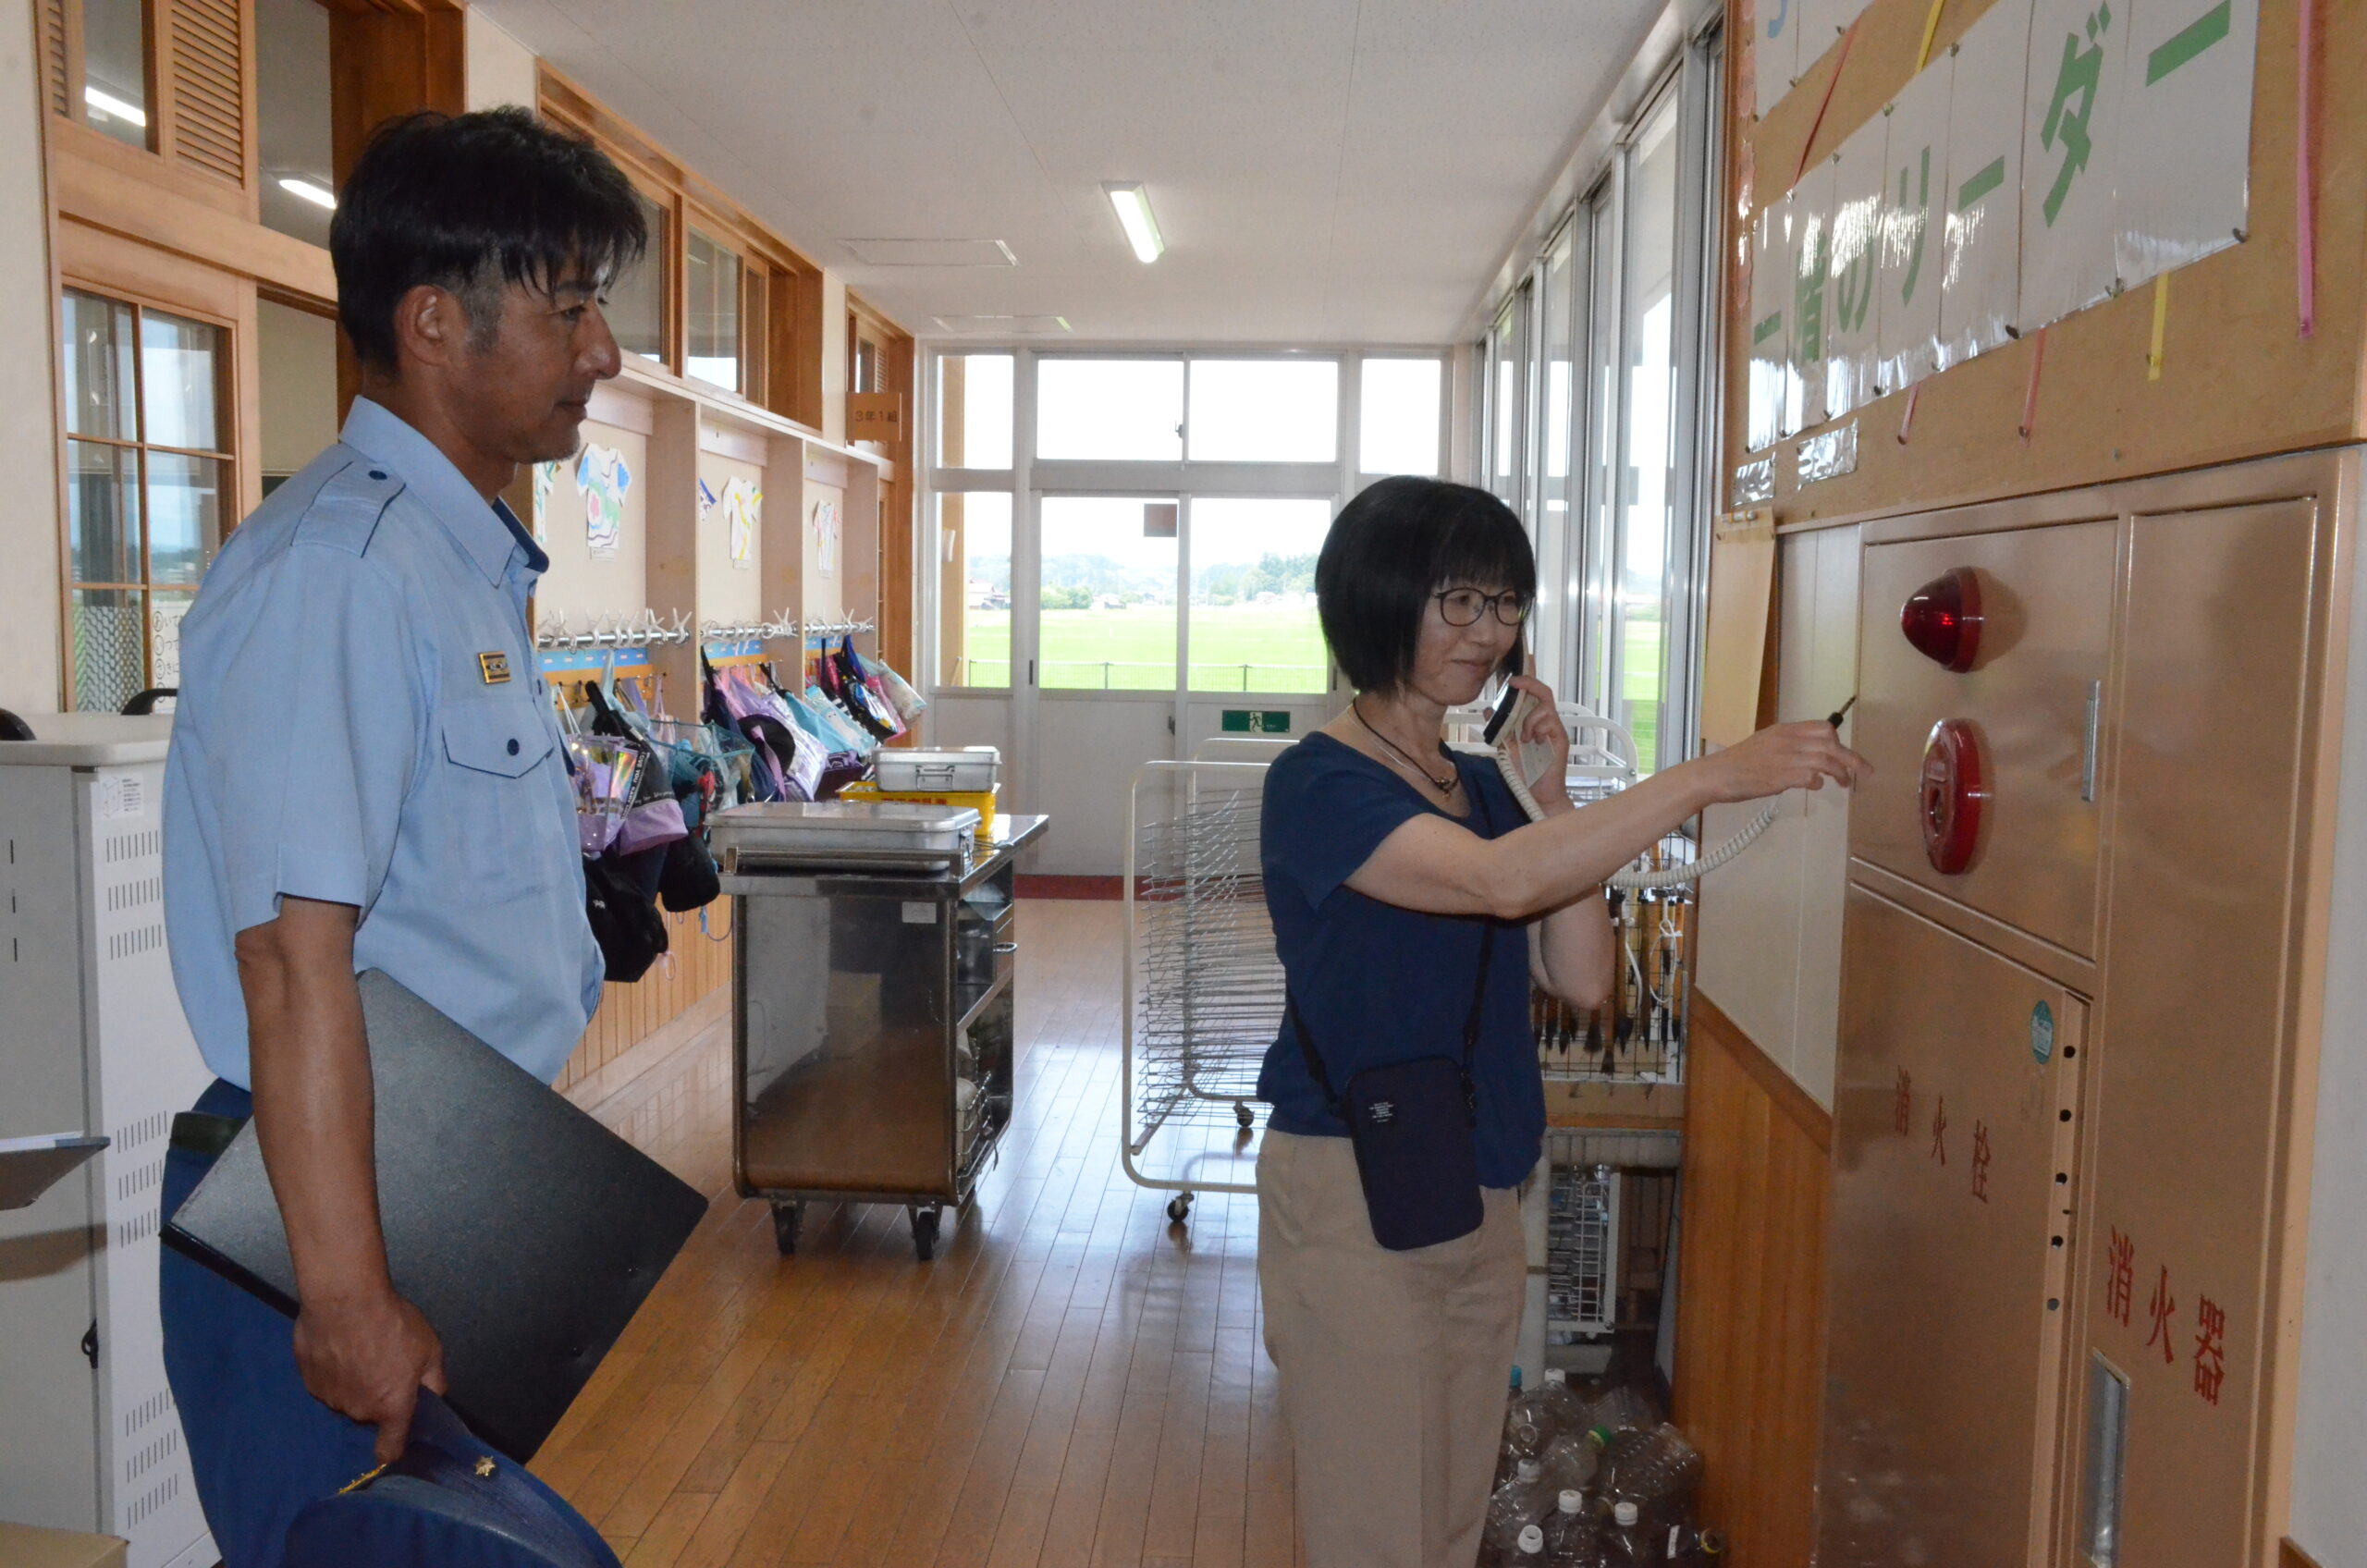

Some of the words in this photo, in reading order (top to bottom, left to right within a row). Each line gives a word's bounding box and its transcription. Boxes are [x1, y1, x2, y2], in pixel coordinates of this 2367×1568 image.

[854, 410, 898, 423] 3年1組
[1895, 1064, 1992, 1204] 消火栓
[2107, 1224, 2226, 1406] 消火器
